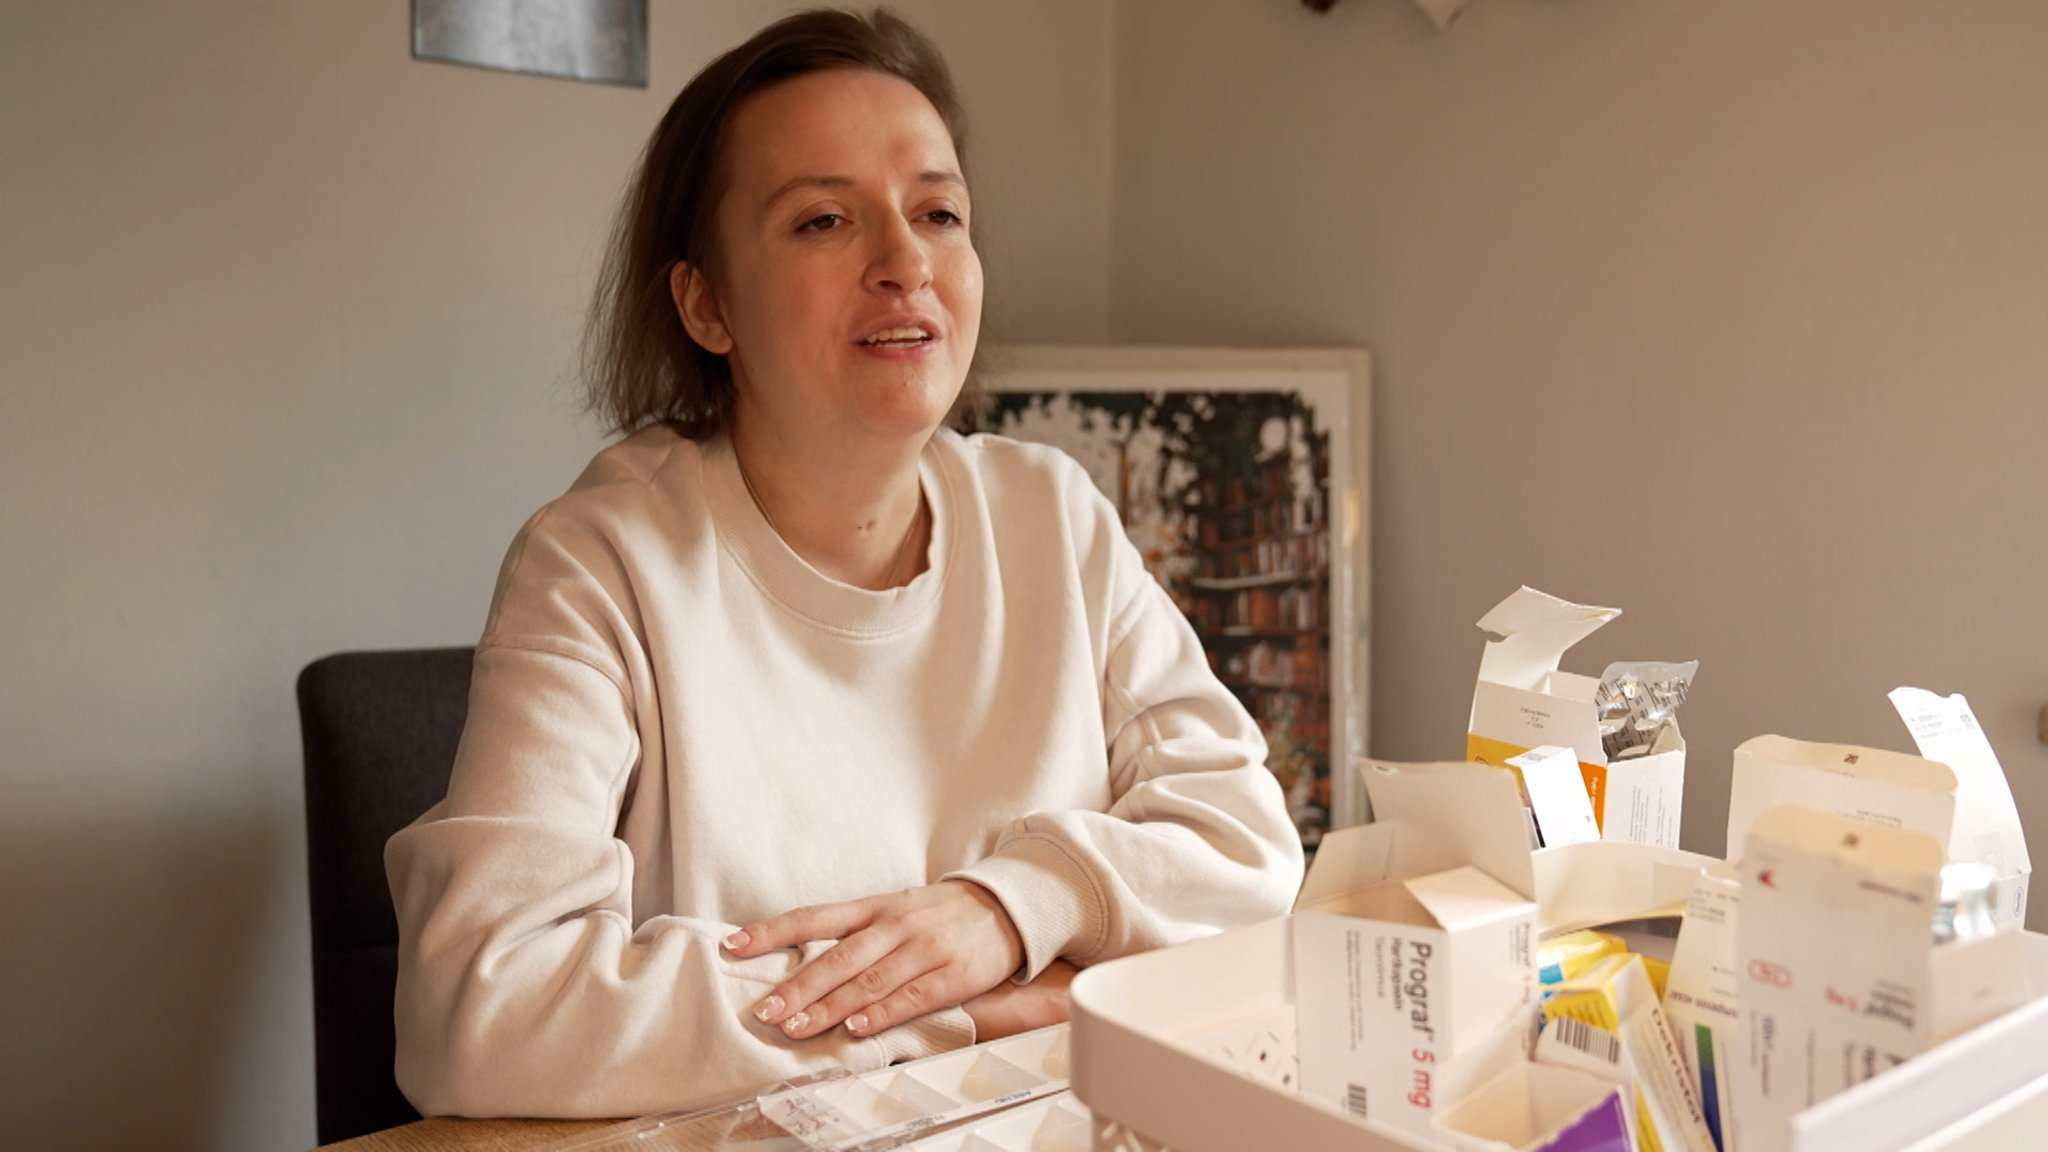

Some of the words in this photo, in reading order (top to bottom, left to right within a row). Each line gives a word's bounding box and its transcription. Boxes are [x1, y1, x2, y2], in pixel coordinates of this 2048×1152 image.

[1403, 940, 1434, 1036] Prograf
[1411, 1048, 1436, 1064] 5
[1408, 1069, 1432, 1109] mg
